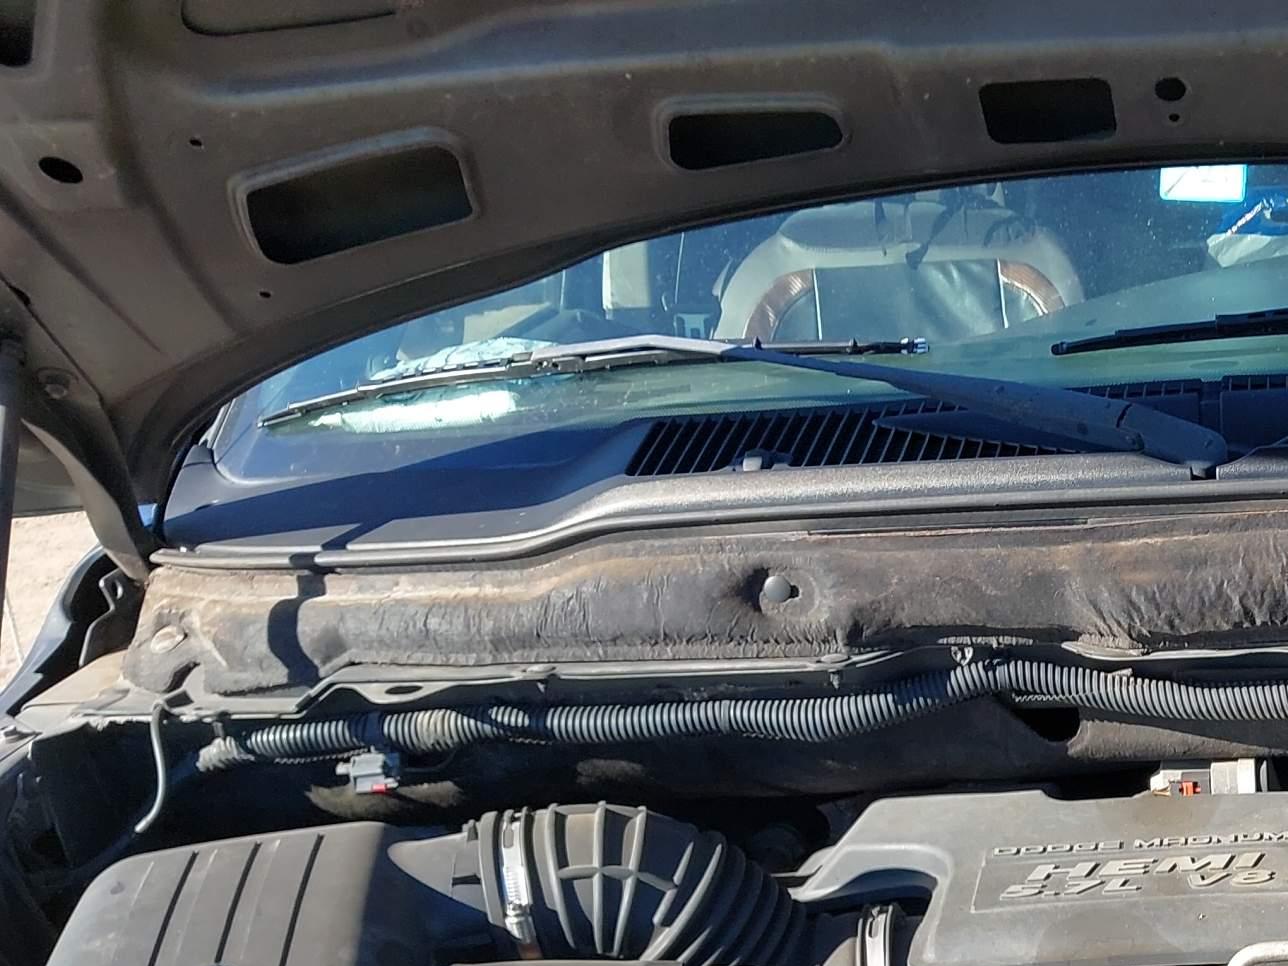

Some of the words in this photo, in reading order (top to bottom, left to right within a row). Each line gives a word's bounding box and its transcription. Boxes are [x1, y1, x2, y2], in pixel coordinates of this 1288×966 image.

[994, 839, 1125, 856] DODGE
[1025, 852, 1266, 881] HEMI
[999, 879, 1142, 900] 5.7L
[1186, 870, 1276, 889] V8
